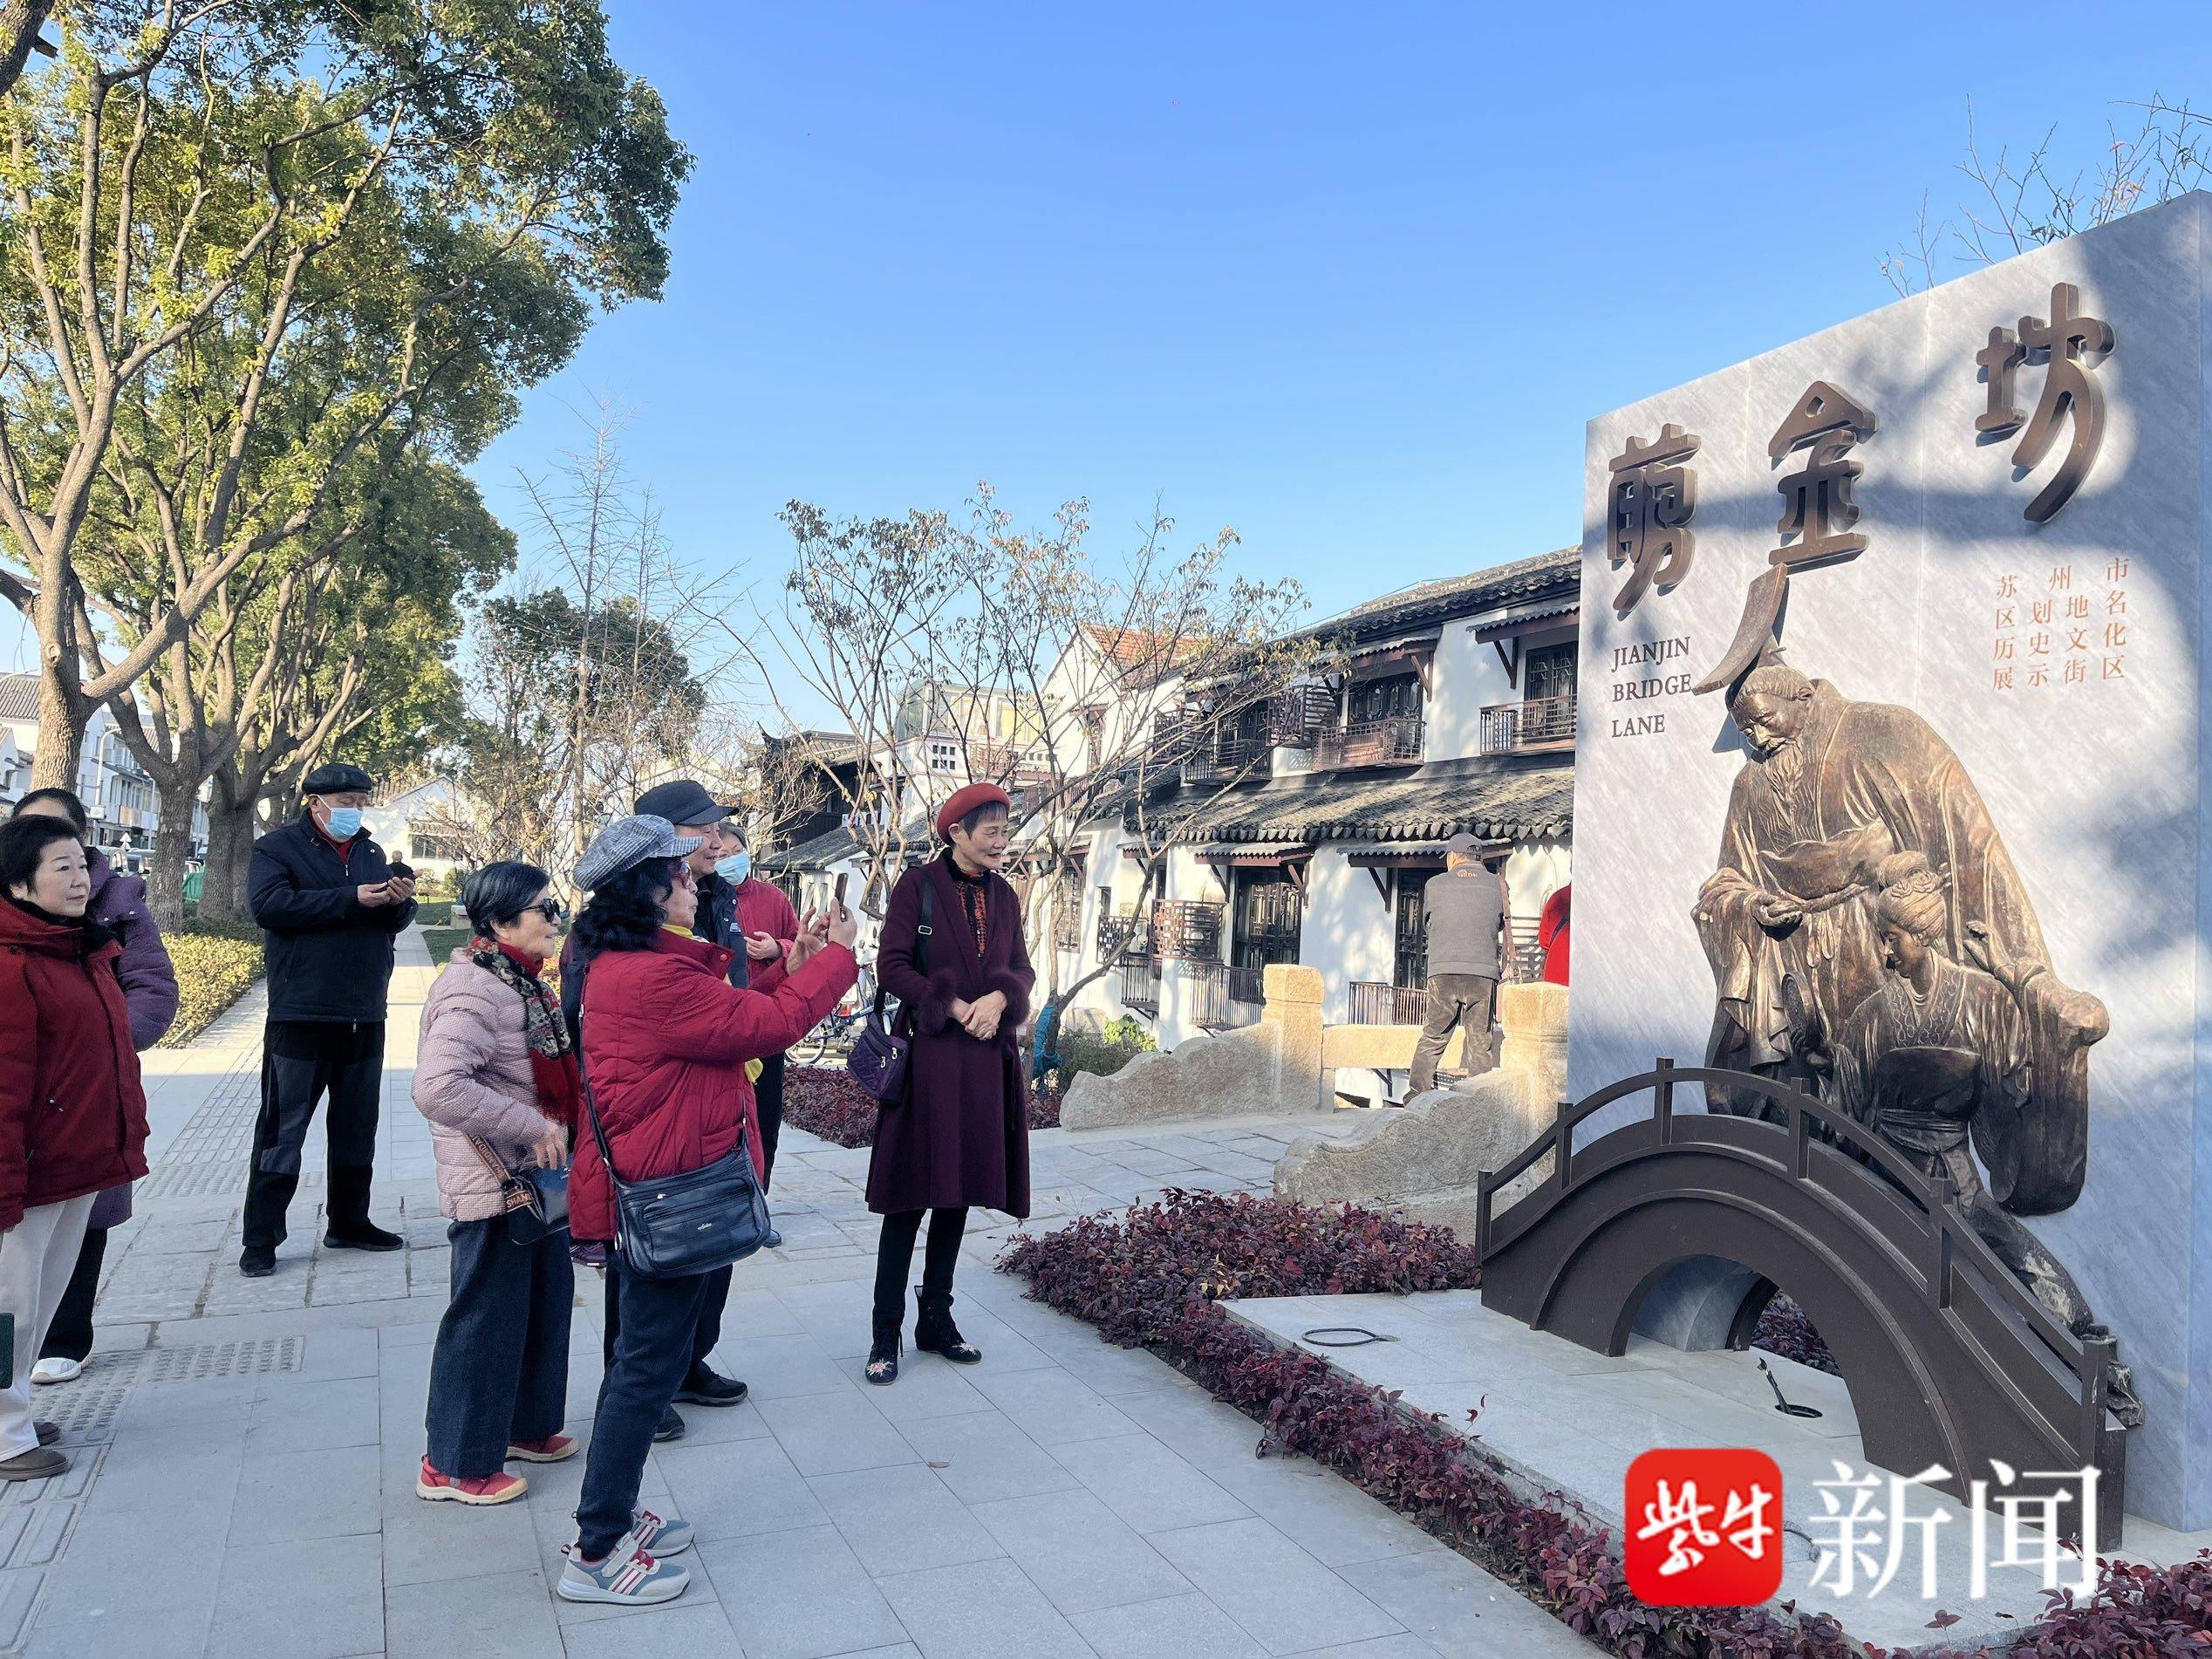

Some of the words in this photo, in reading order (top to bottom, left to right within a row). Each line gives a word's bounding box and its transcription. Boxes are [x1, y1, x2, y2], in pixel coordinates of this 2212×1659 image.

[1996, 557, 2130, 599] 苏州市
[1995, 590, 2126, 630] 区划地名
[1611, 636, 1690, 673] JIANJIN
[1992, 622, 2127, 662] 历史文化
[1612, 673, 1692, 703] BRIDGE
[1992, 655, 2125, 692] 展示街区
[1611, 713, 1665, 738] LANE
